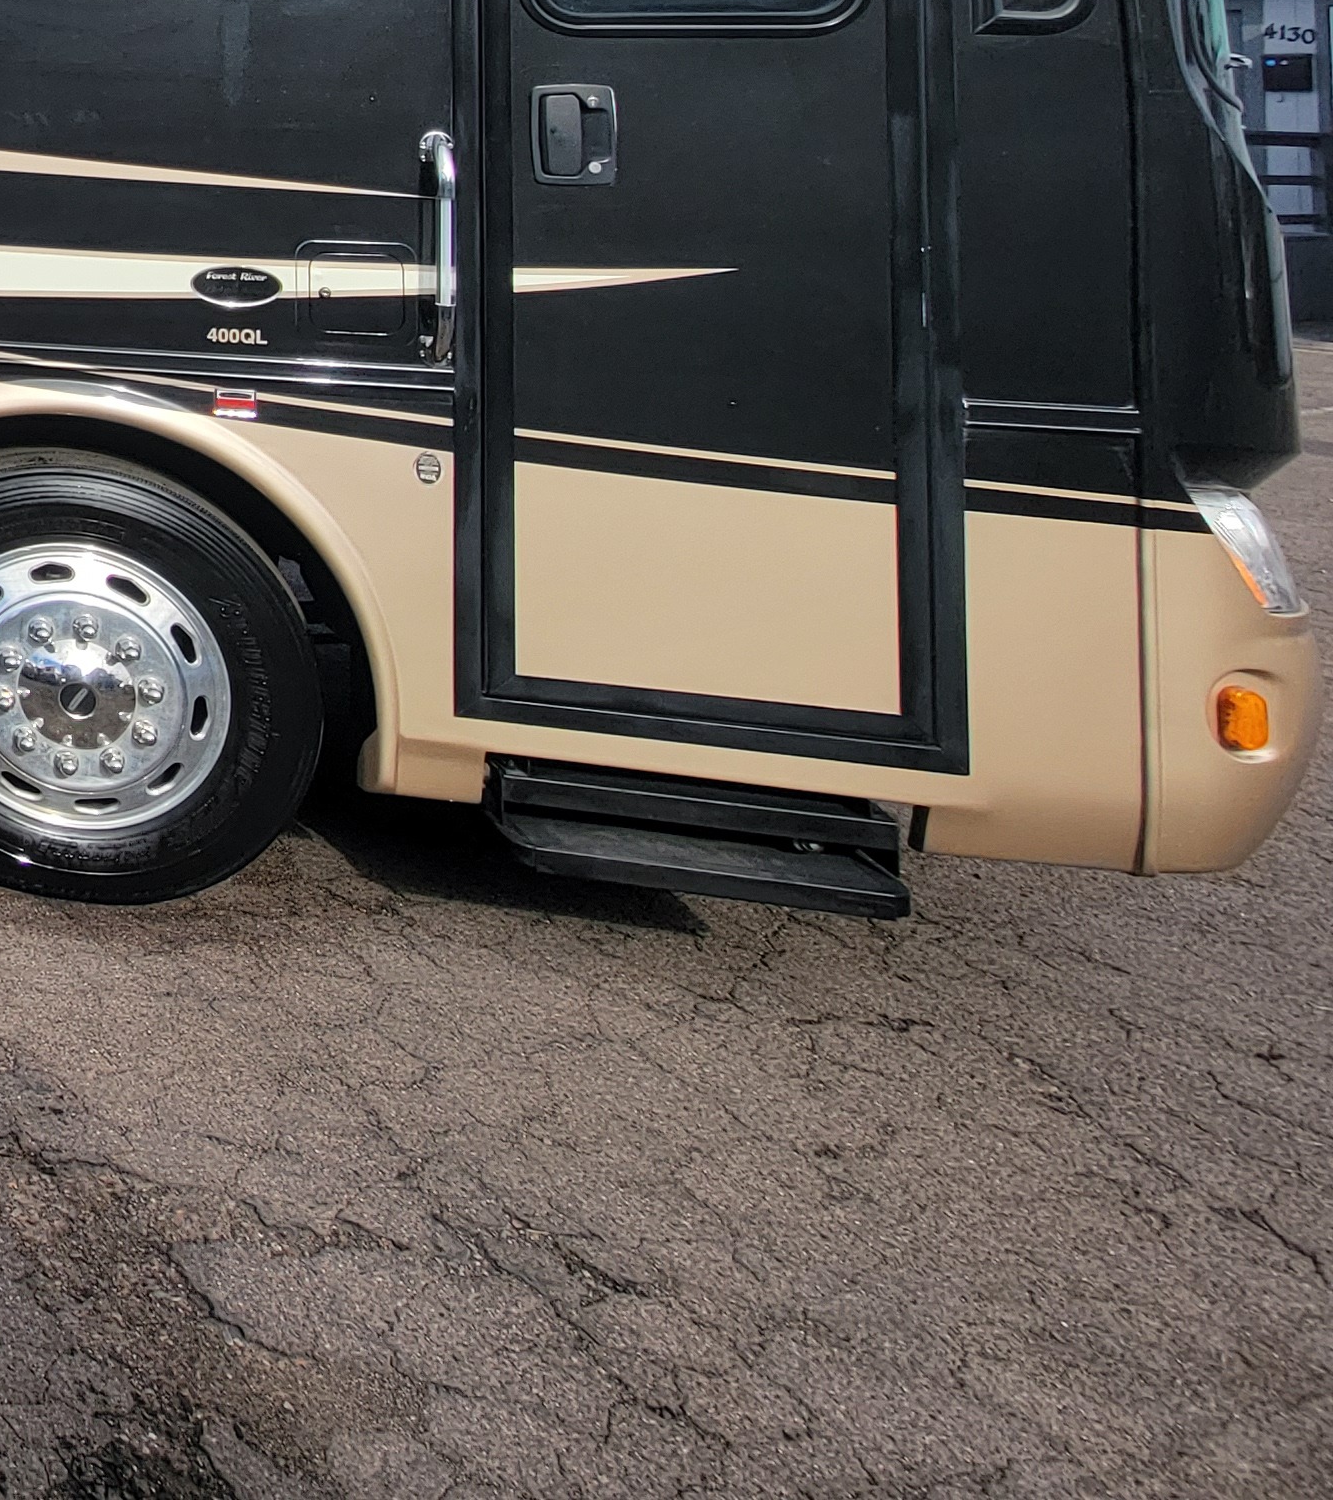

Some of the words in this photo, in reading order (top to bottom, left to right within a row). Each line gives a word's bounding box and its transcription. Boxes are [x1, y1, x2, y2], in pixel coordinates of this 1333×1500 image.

[1264, 23, 1316, 45] 4130
[206, 270, 237, 281] Forest
[239, 272, 268, 282] River
[206, 327, 269, 345] 400QL
